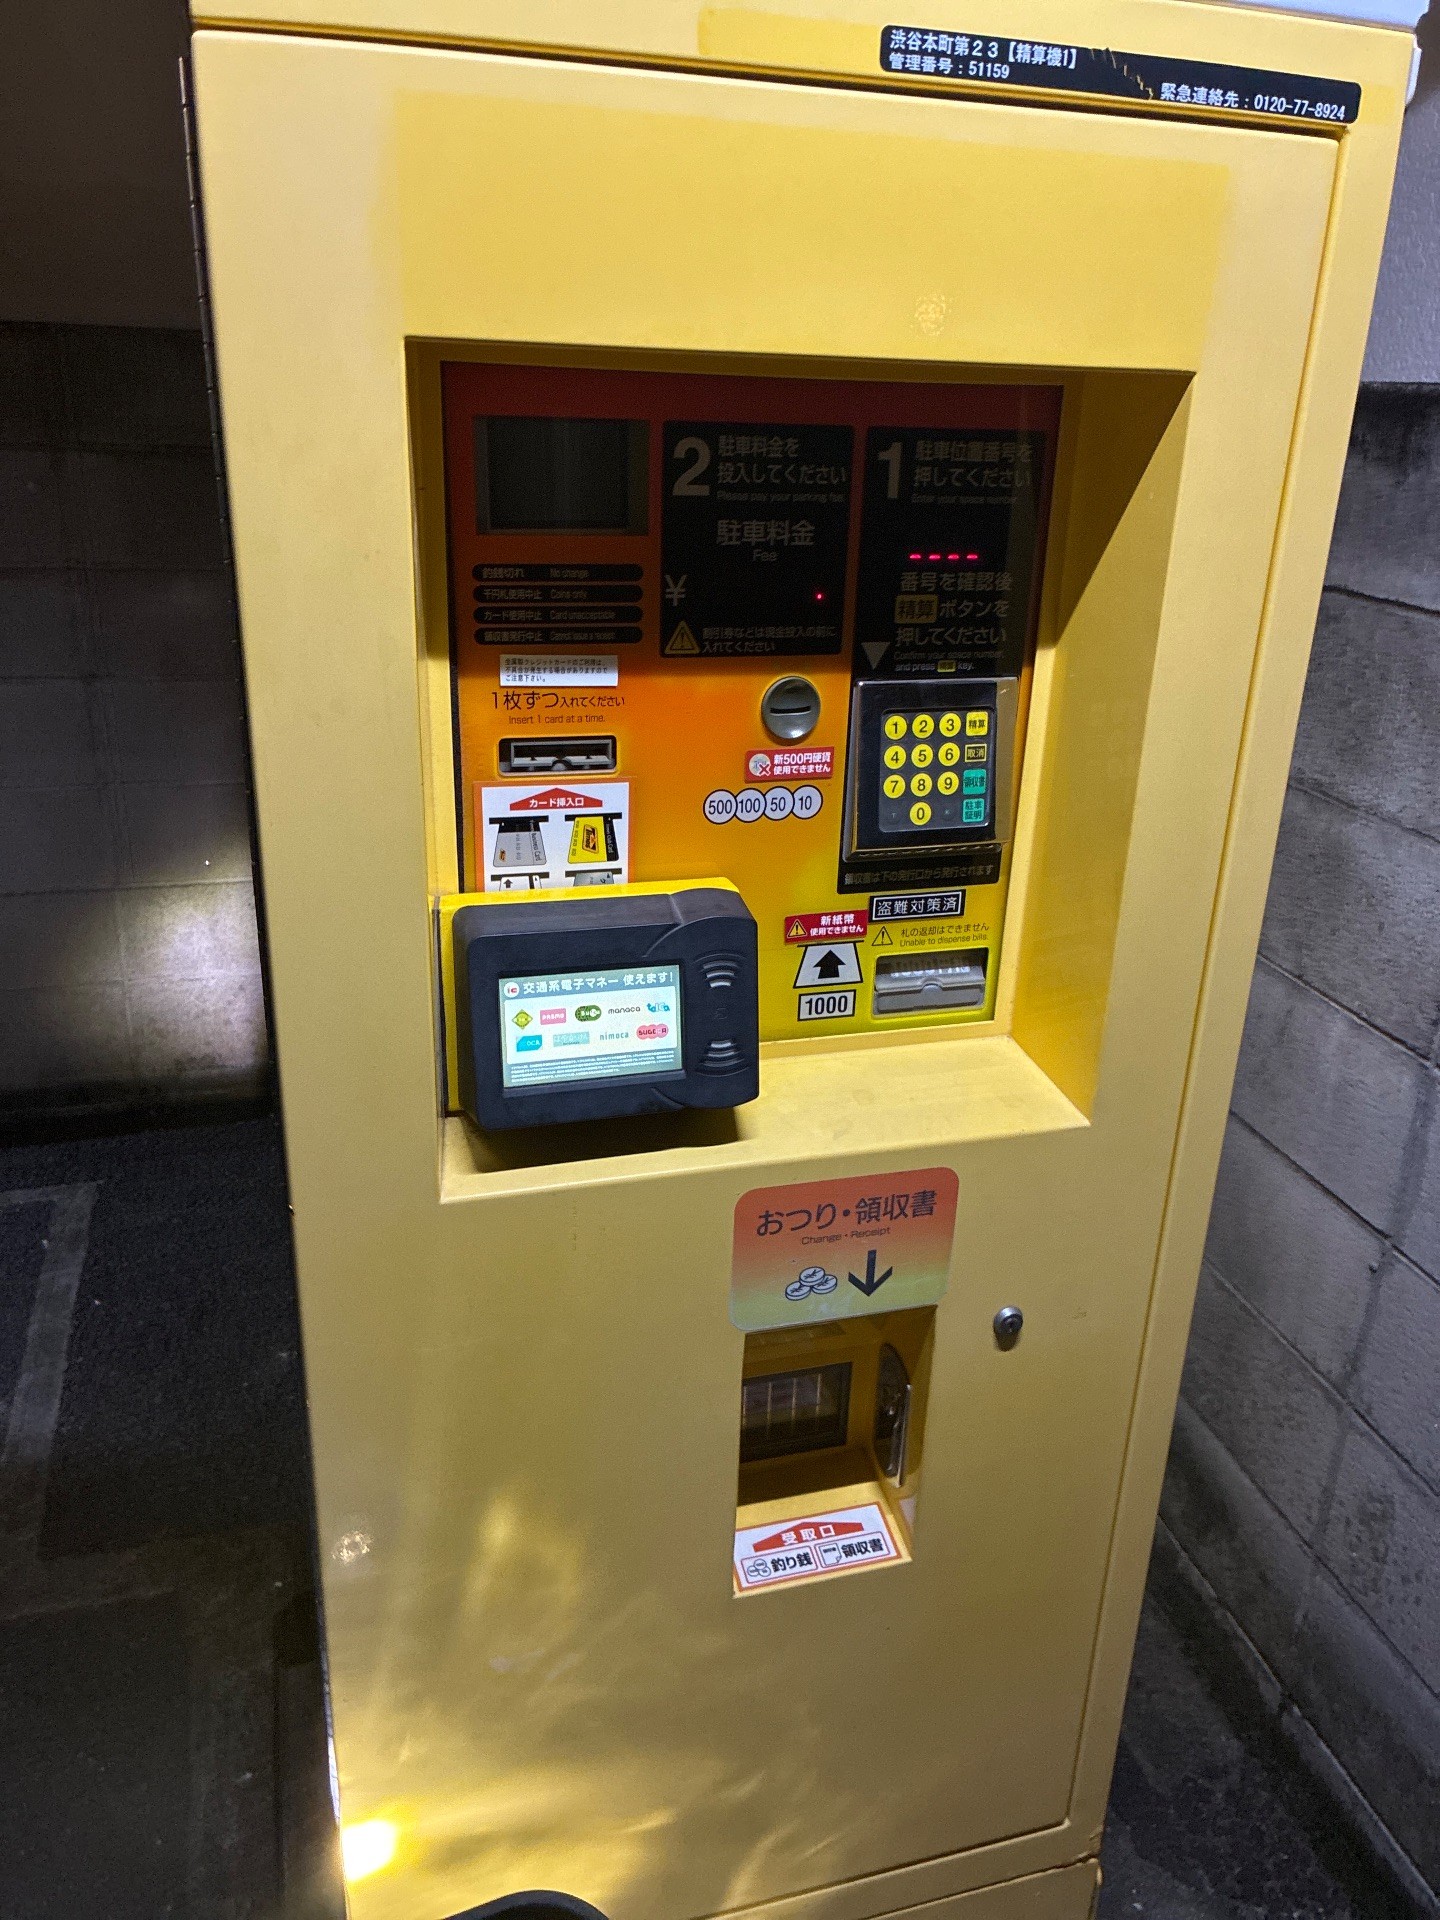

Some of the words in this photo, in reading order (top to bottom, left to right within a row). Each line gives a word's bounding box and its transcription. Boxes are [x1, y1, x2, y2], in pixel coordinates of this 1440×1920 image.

[717, 434, 799, 459] 駐車料金を
[672, 436, 711, 496] 2
[717, 461, 847, 485] 投入してください
[877, 441, 903, 498] 1
[913, 466, 1033, 488] 押してください
[716, 518, 816, 547] 駐車料金
[752, 549, 779, 562] Fee
[664, 574, 688, 606] ¥
[900, 571, 1013, 592] 番号を確認後
[898, 600, 935, 620] 精算
[939, 600, 1010, 618] ボタンを
[895, 627, 1007, 647] 押してください
[702, 641, 776, 654] 入れてください
[491, 690, 625, 711] 1枚ずつ入れてください
[508, 715, 533, 725] Insert
[544, 715, 564, 724] card
[565, 715, 575, 723] at
[585, 714, 606, 723] time.
[891, 720, 899, 735] 1
[919, 719, 928, 734] 2
[946, 718, 955, 732] 3
[968, 719, 986, 729] 精算
[773, 751, 831, 765] 新500円硬貨
[890, 750, 900, 764] 4
[918, 749, 927, 763] 5
[945, 747, 954, 761] 6
[773, 764, 831, 775] 使用できません
[890, 780, 899, 794] 7
[917, 779, 926, 792] 8
[944, 777, 953, 790] 9
[529, 797, 585, 808] カード挿入口
[708, 799, 733, 815] 500
[738, 798, 761, 814] 100
[770, 797, 786, 812] 50
[798, 795, 812, 810] 10
[916, 807, 925, 821] 0
[877, 896, 958, 916] 盗難対策済
[820, 913, 855, 926] 新紙幣
[809, 923, 864, 937] 使用できません
[900, 922, 990, 938] 札の返却はできません
[899, 936, 926, 948] Unable
[927, 936, 936, 945] to
[937, 934, 970, 946] dispense
[522, 976, 619, 995] 交通系電子マネー
[608, 1006, 641, 1015] manaca
[804, 995, 848, 1016] 1000
[599, 1031, 629, 1041] nimoca
[756, 1189, 938, 1237] おつり・領収書
[780, 1524, 836, 1546] 受取口
[841, 1538, 884, 1559] 領収書
[770, 1551, 813, 1573] 釣り銭
